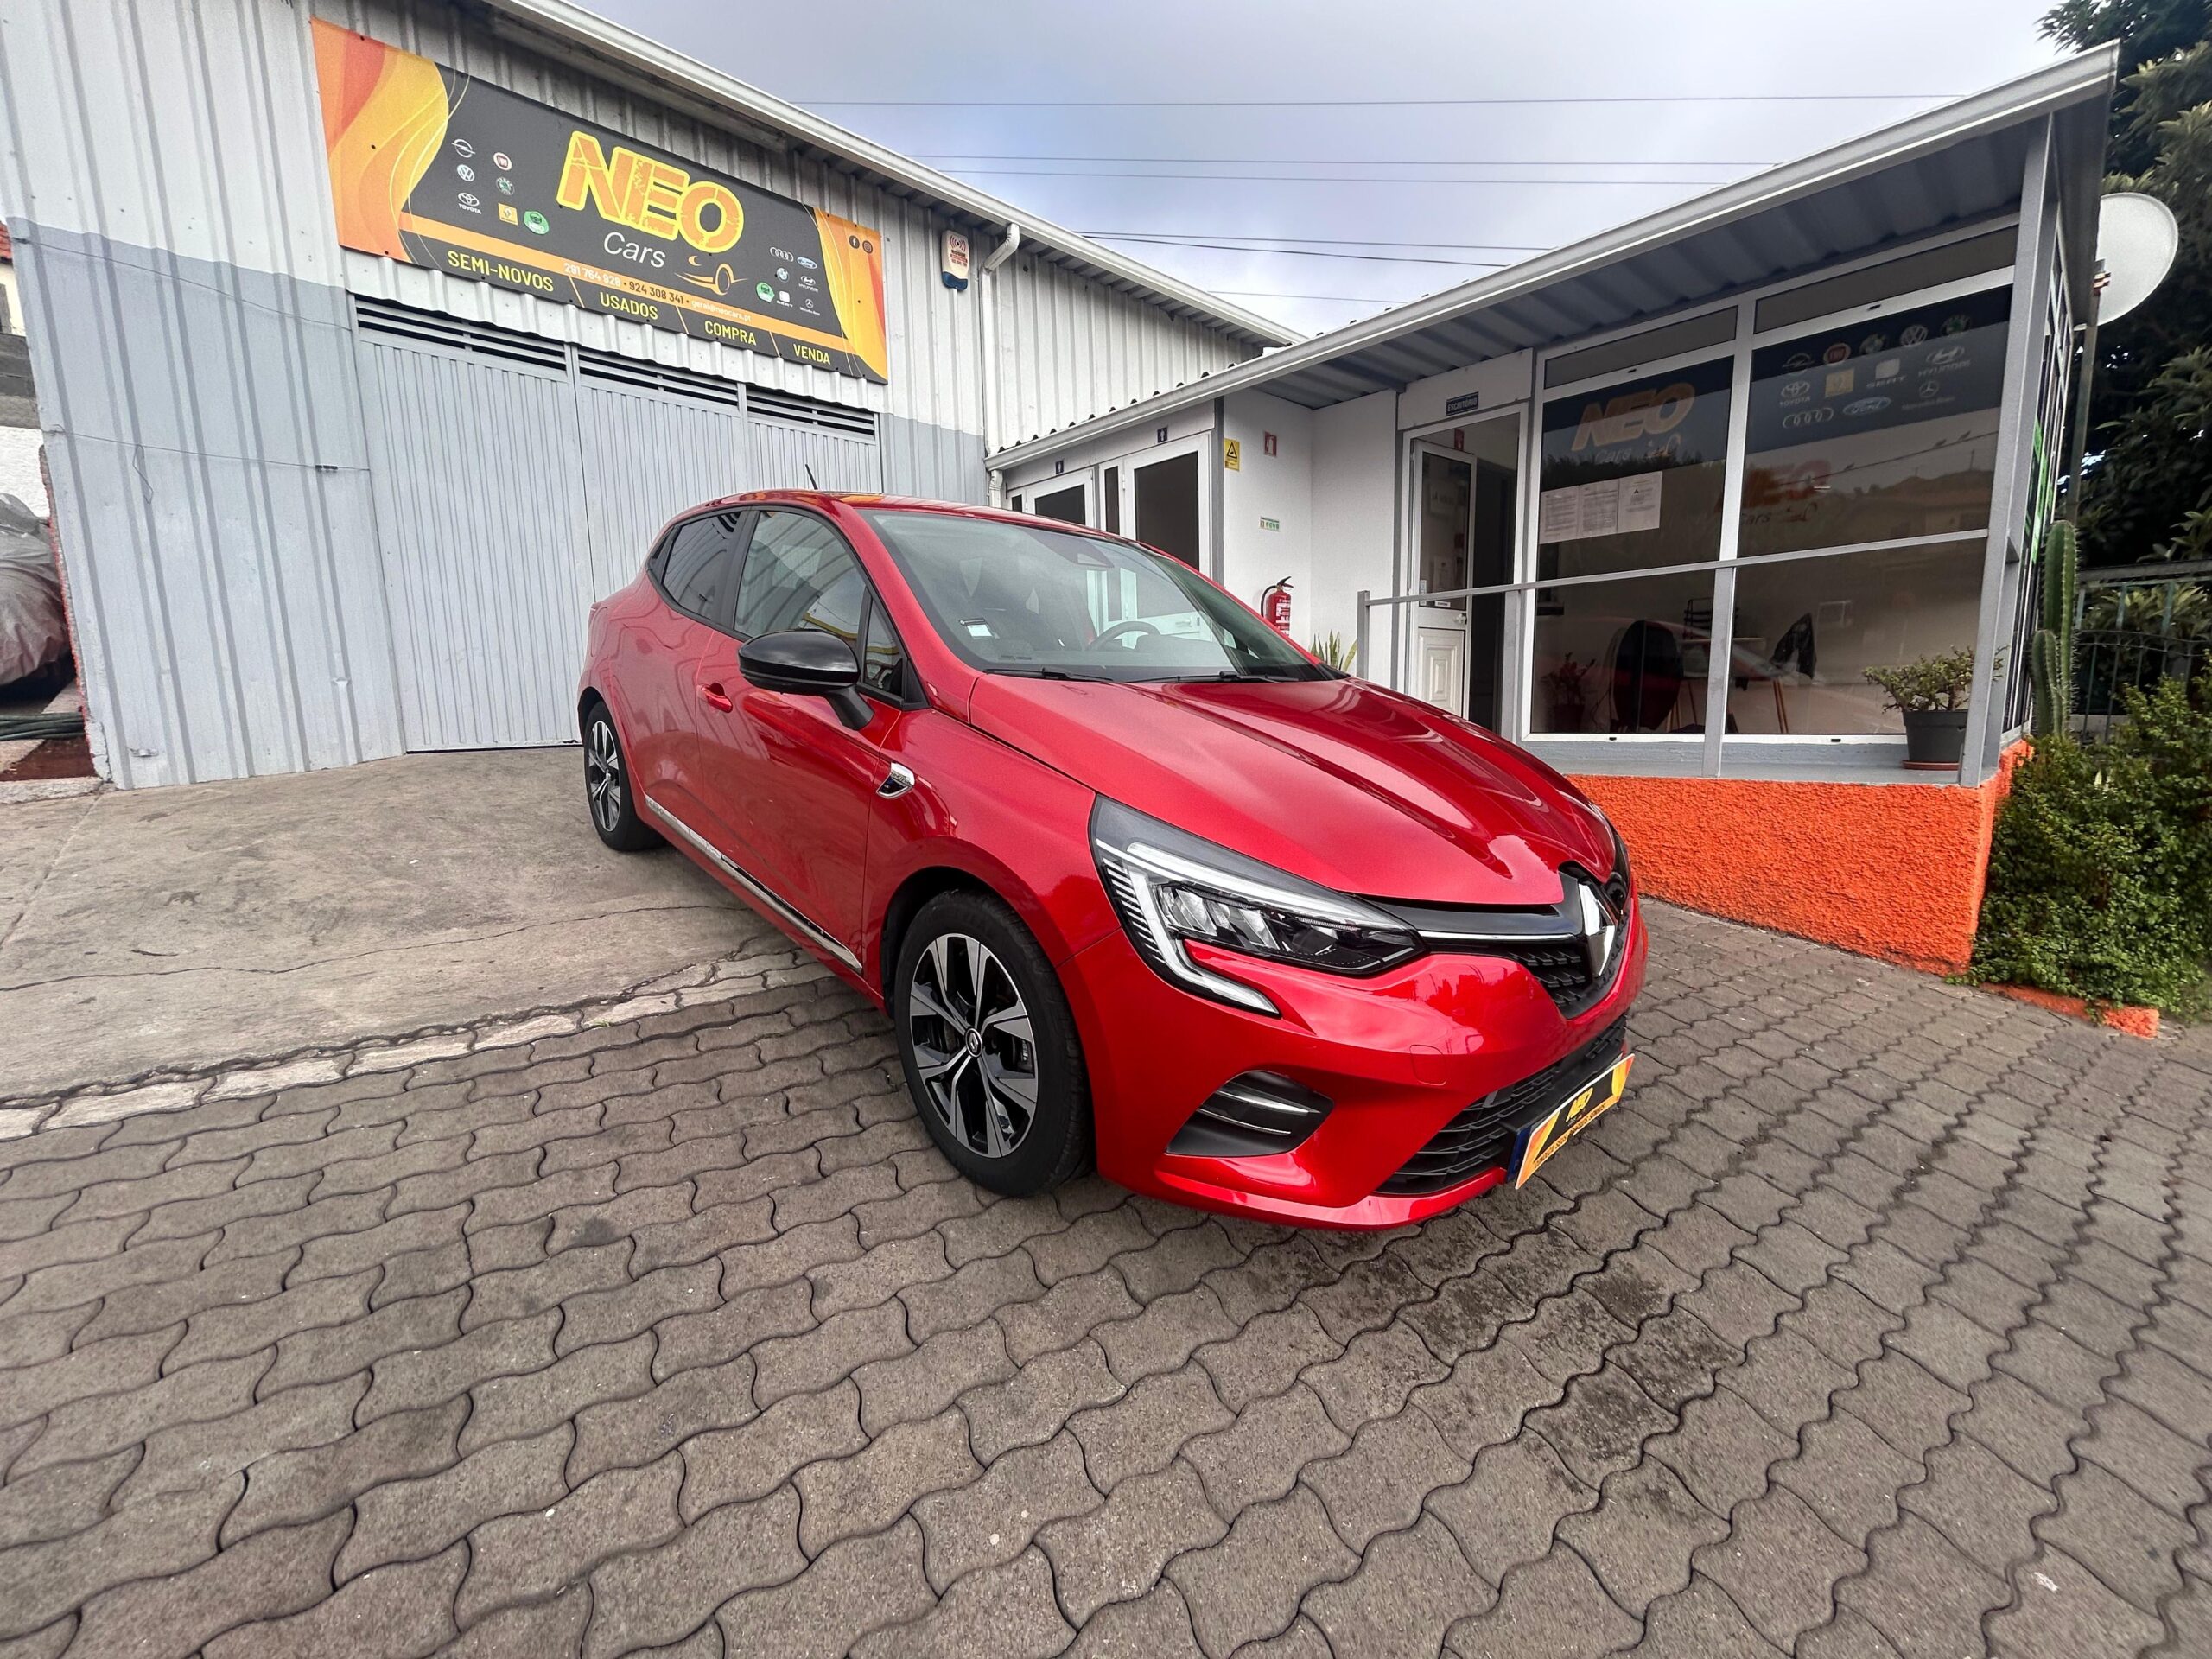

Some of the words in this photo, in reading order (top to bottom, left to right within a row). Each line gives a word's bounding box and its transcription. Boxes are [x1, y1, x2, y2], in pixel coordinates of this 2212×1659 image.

[458, 203, 482, 214] TOYOTA
[556, 130, 744, 253] NEO
[604, 232, 666, 268] Cars
[448, 251, 554, 292] SEMI-NOVOS
[563, 263, 581, 276] 291
[583, 267, 601, 281] 764
[603, 272, 621, 287] 928
[629, 281, 647, 295] 924
[650, 287, 667, 300] 308
[669, 292, 684, 304] 341
[600, 292, 658, 321] USADOS
[704, 321, 757, 346] COMPRA
[793, 344, 831, 365] VENDA
[1571, 382, 1696, 452] NEO
